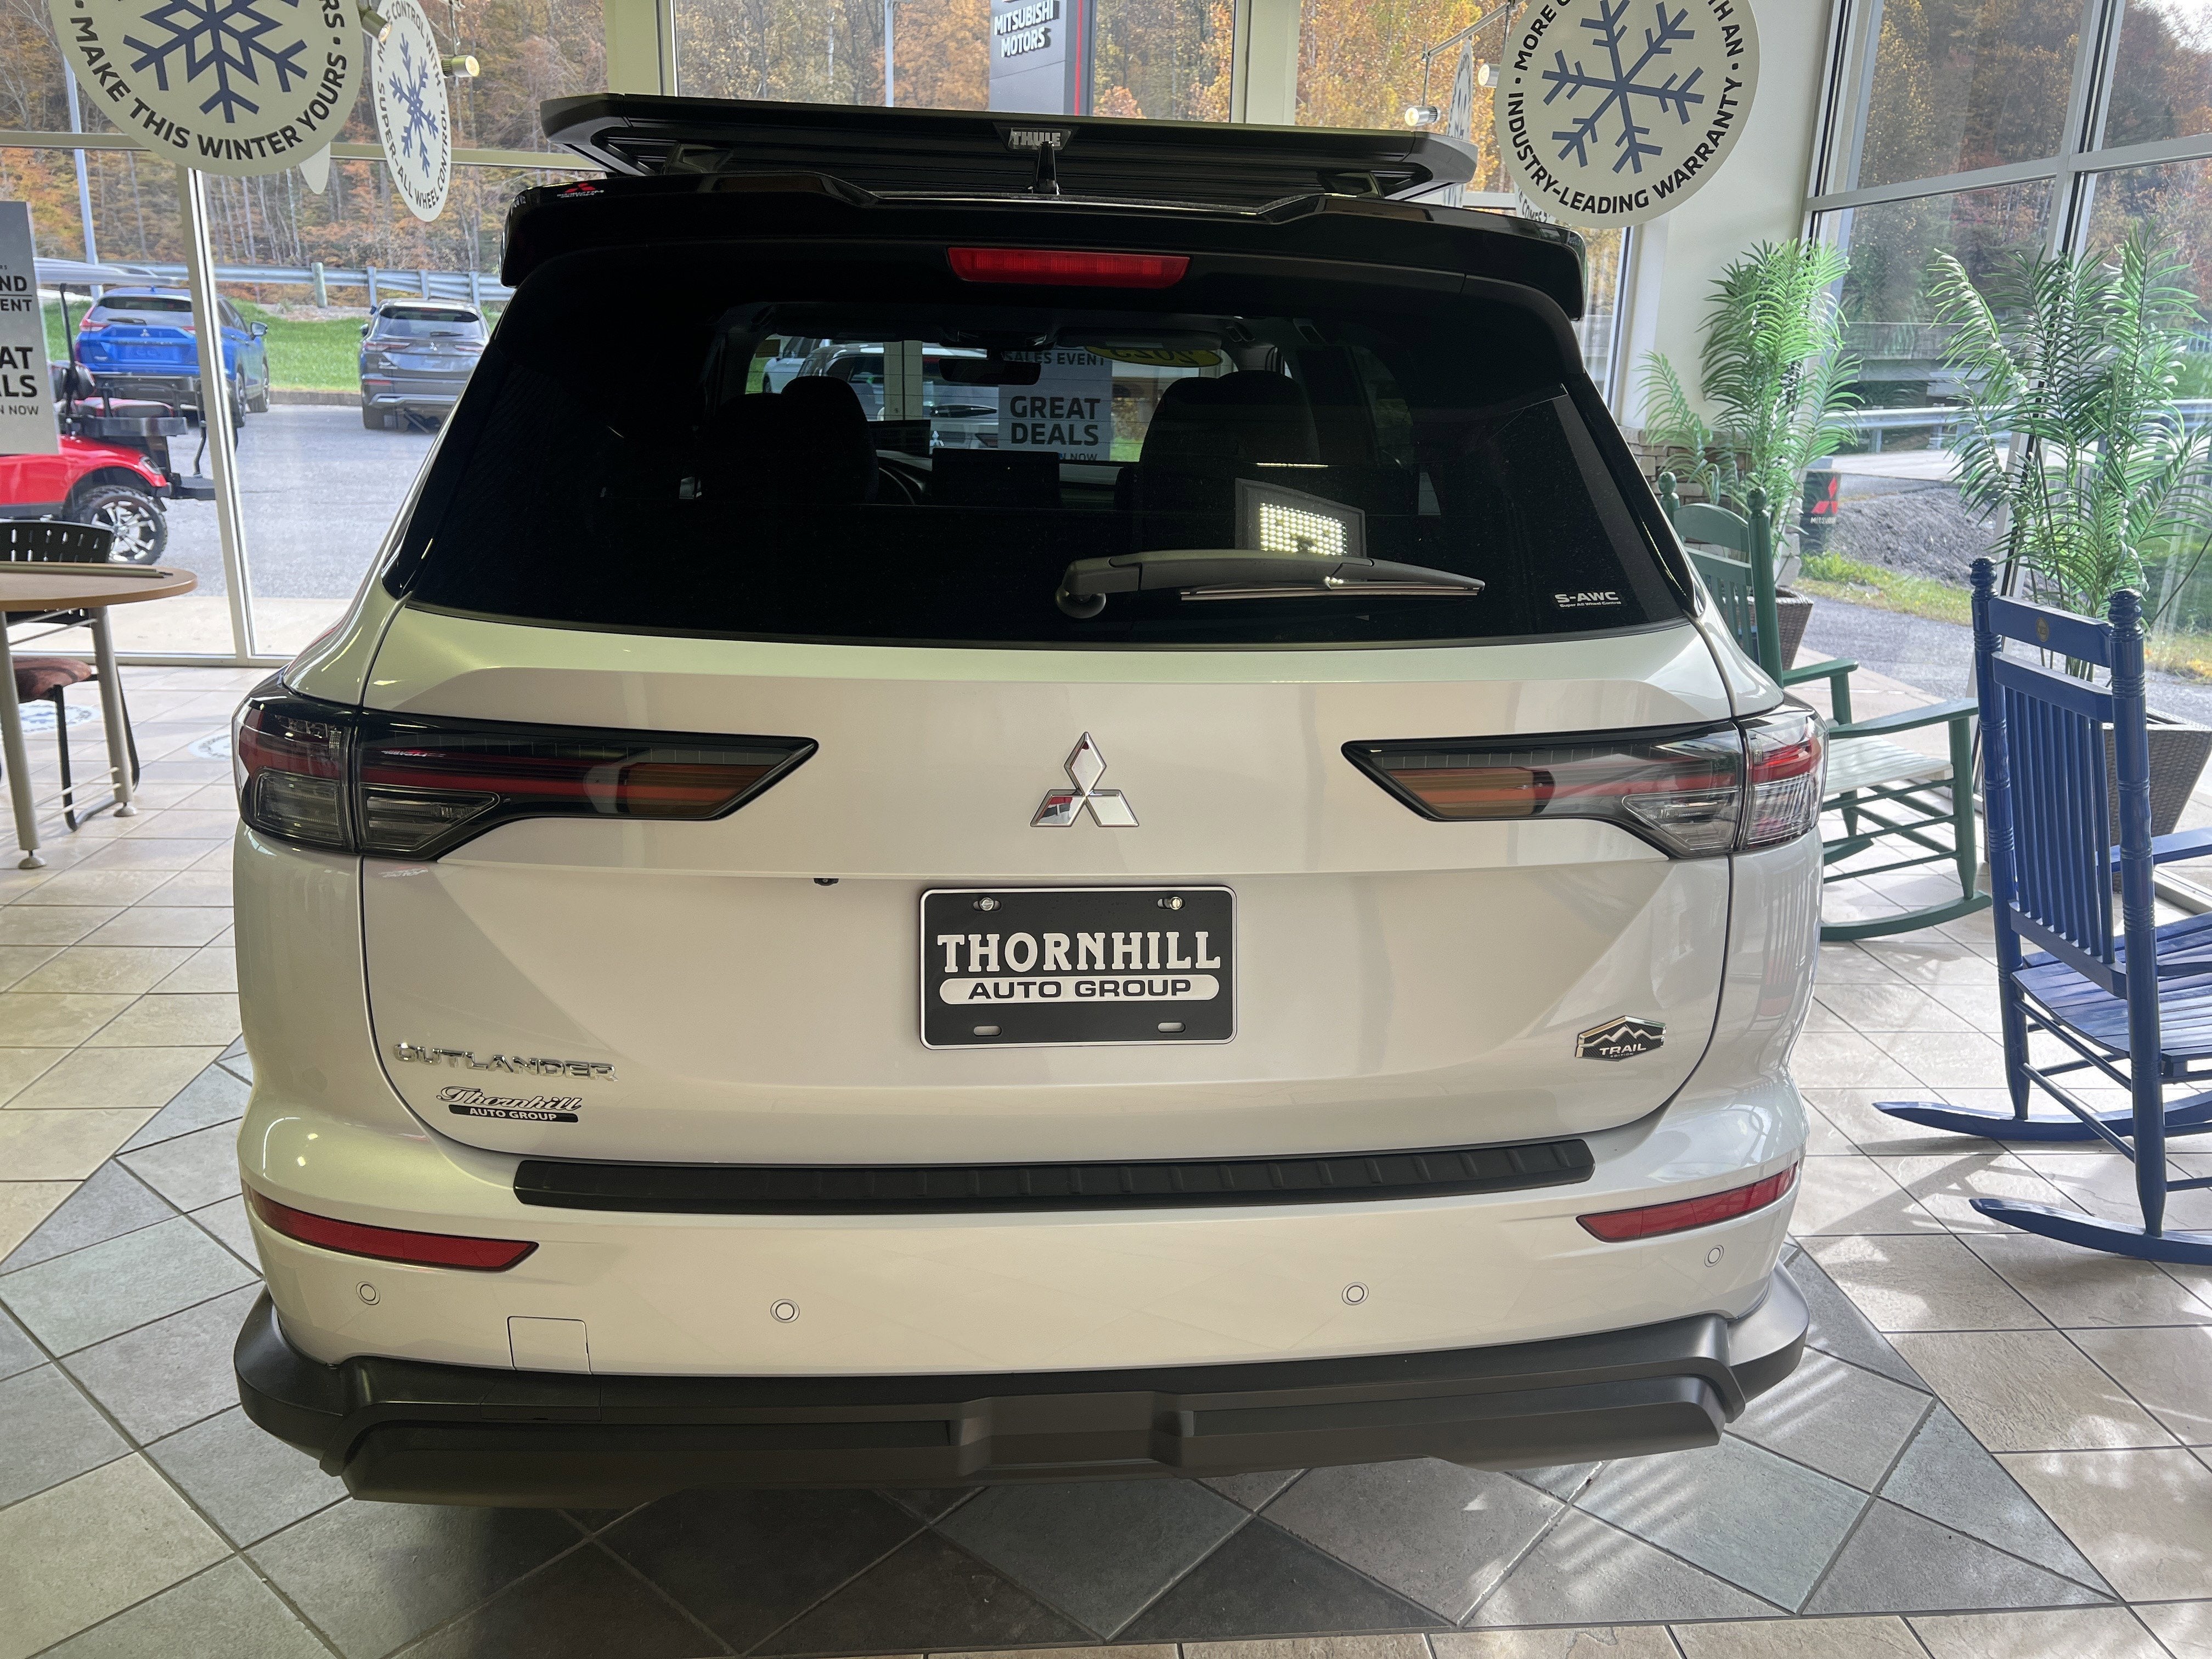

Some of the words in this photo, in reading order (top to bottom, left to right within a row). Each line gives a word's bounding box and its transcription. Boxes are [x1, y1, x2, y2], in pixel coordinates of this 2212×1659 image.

[994, 0, 1054, 35] MITSUBISHI
[392, 1, 426, 39] CONTROL
[426, 33, 441, 87] WITH
[1001, 26, 1045, 58] MOTORS
[1514, 4, 1557, 71] MORE
[1722, 24, 1744, 57] AN
[70, 16, 132, 103] MAKE
[129, 97, 190, 149] THIS
[197, 125, 303, 160] WINTER
[296, 52, 347, 132] YOURS
[1651, 77, 1743, 199] WARRANTY
[414, 188, 439, 209] WHEEL
[437, 104, 448, 192] CONTROL
[0, 374, 38, 398] LS
[9, 405, 39, 415] NOW
[1010, 396, 1101, 420] GREAT
[1011, 422, 1099, 446] DEALS
[1555, 591, 1619, 603] S-AWC
[936, 931, 1221, 973] THORNHILL
[967, 980, 1062, 1000] AUTO
[1074, 979, 1192, 997] GROUP
[393, 1042, 619, 1082] OUTLANDER
[1599, 1043, 1646, 1056] TRAIL
[436, 1086, 583, 1111] Thornhill
[469, 1107, 506, 1118] AUTO
[509, 1110, 557, 1121] GROUP
